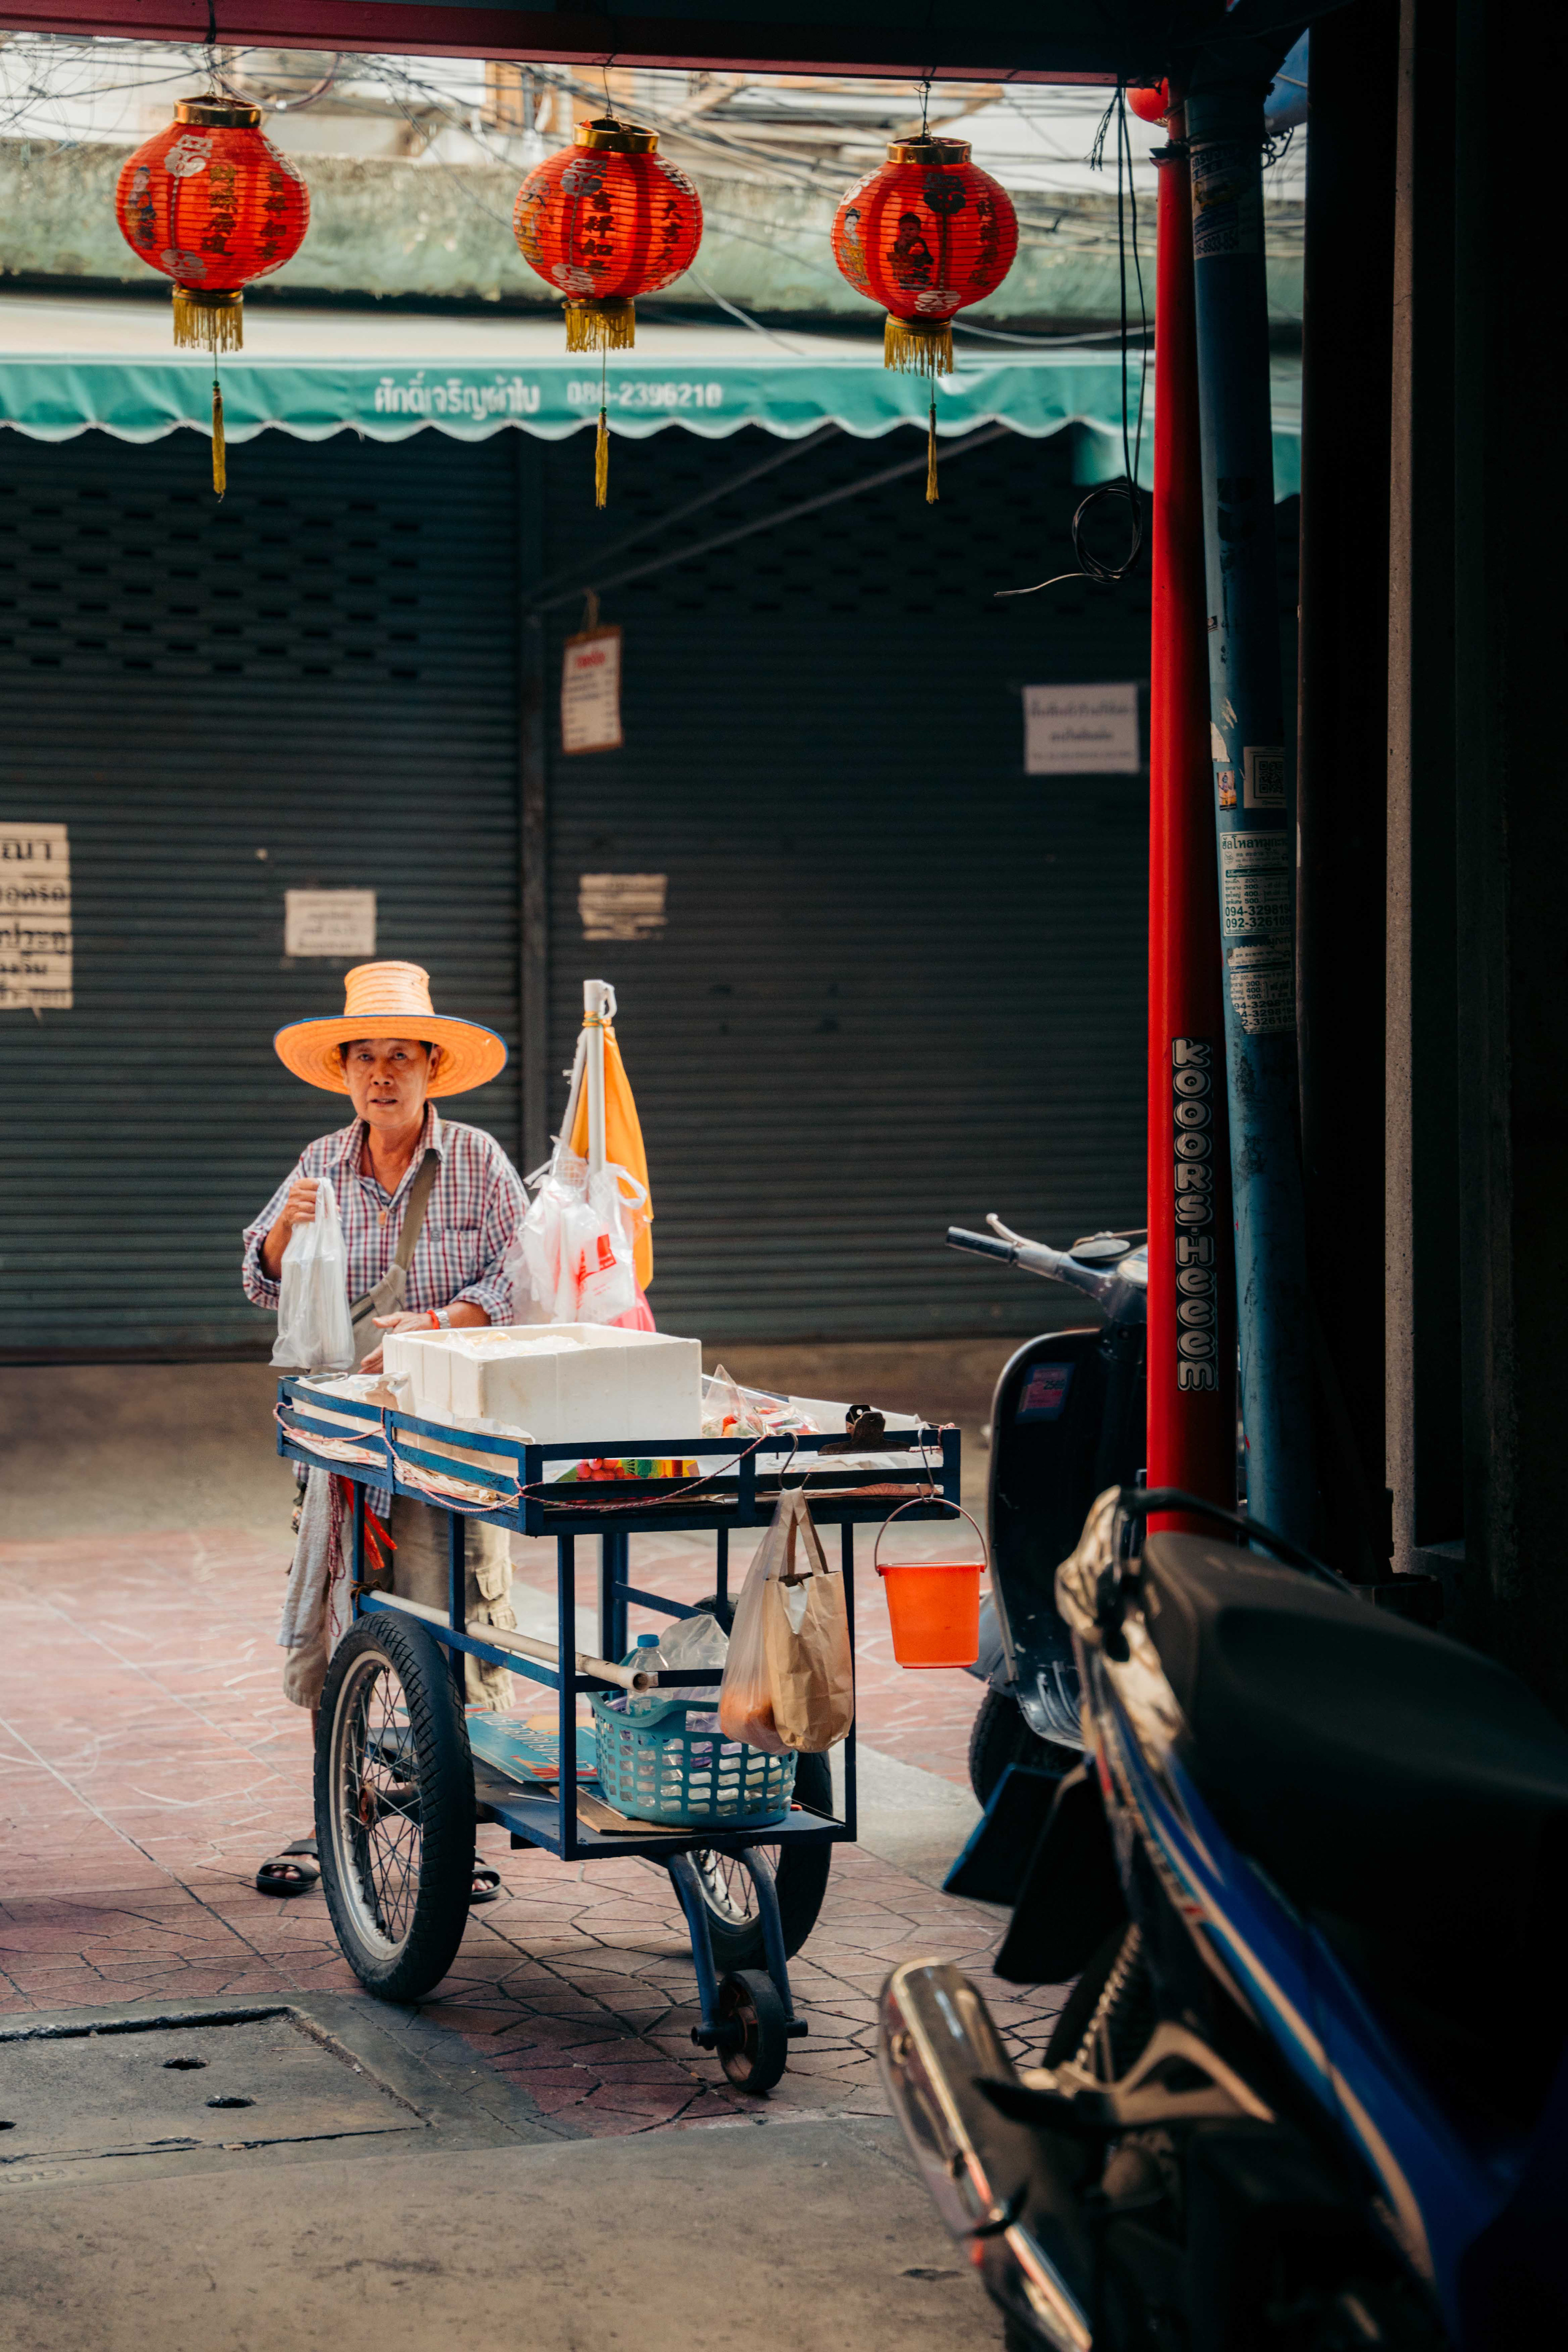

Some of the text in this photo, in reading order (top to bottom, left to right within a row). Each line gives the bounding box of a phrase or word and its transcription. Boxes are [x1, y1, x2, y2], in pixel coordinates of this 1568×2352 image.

[580, 190, 615, 278] 吉祥如意
[567, 381, 722, 408] 086-2396210
